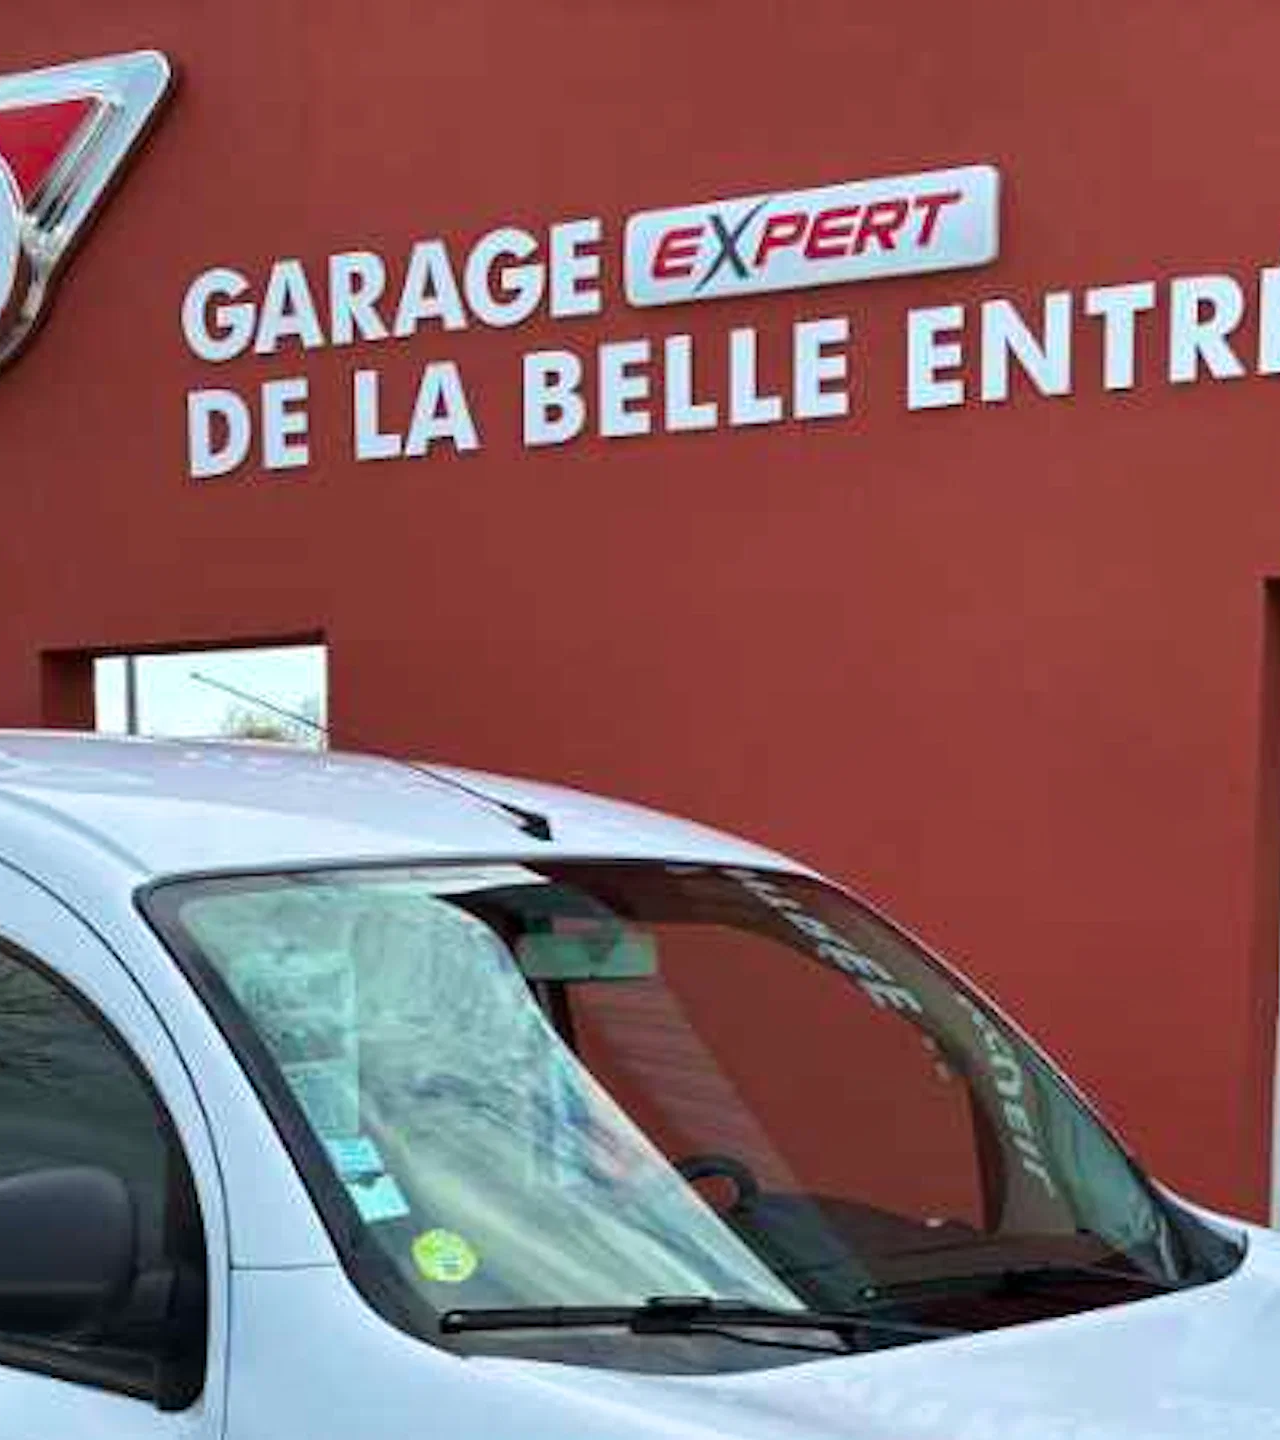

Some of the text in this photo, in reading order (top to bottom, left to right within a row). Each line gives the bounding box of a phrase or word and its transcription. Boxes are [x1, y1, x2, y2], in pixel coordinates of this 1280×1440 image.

[181, 218, 602, 363] GARAGE
[650, 190, 962, 292] EXPERT
[187, 379, 311, 479] DE
[353, 361, 480, 460] LA
[522, 318, 850, 448] BELLE
